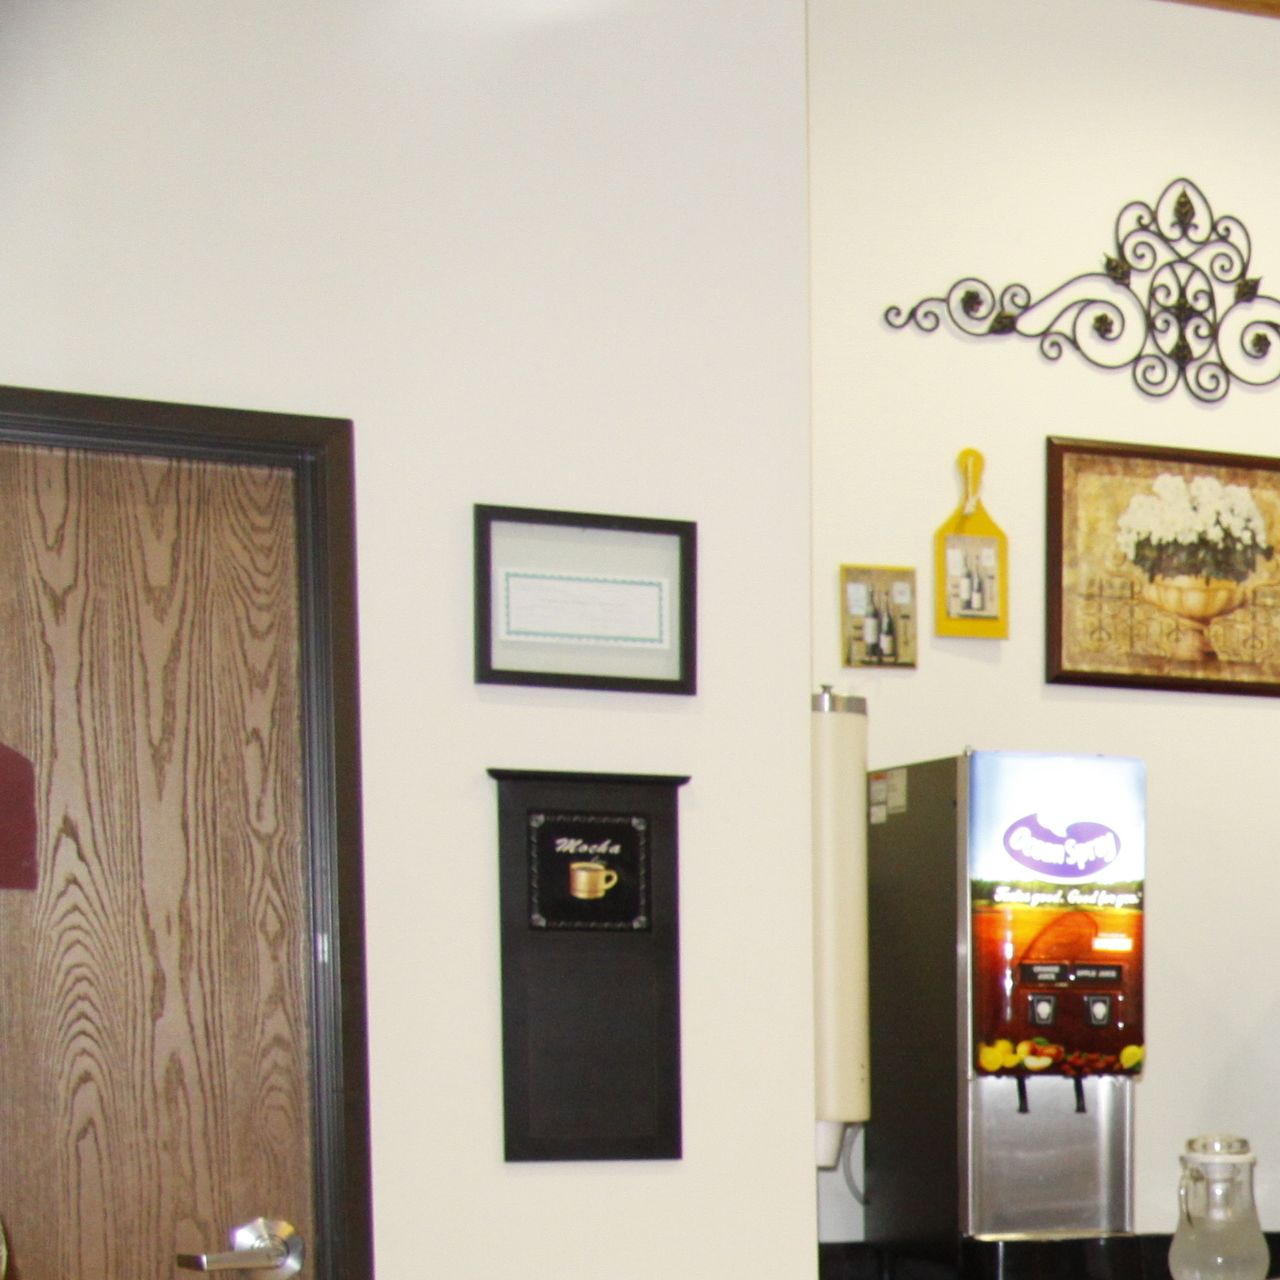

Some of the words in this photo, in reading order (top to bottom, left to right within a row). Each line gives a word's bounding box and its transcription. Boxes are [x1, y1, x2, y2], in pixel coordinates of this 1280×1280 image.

[555, 837, 621, 855] Mocha
[1008, 826, 1065, 865] Ocean
[1064, 831, 1117, 871] Spray
